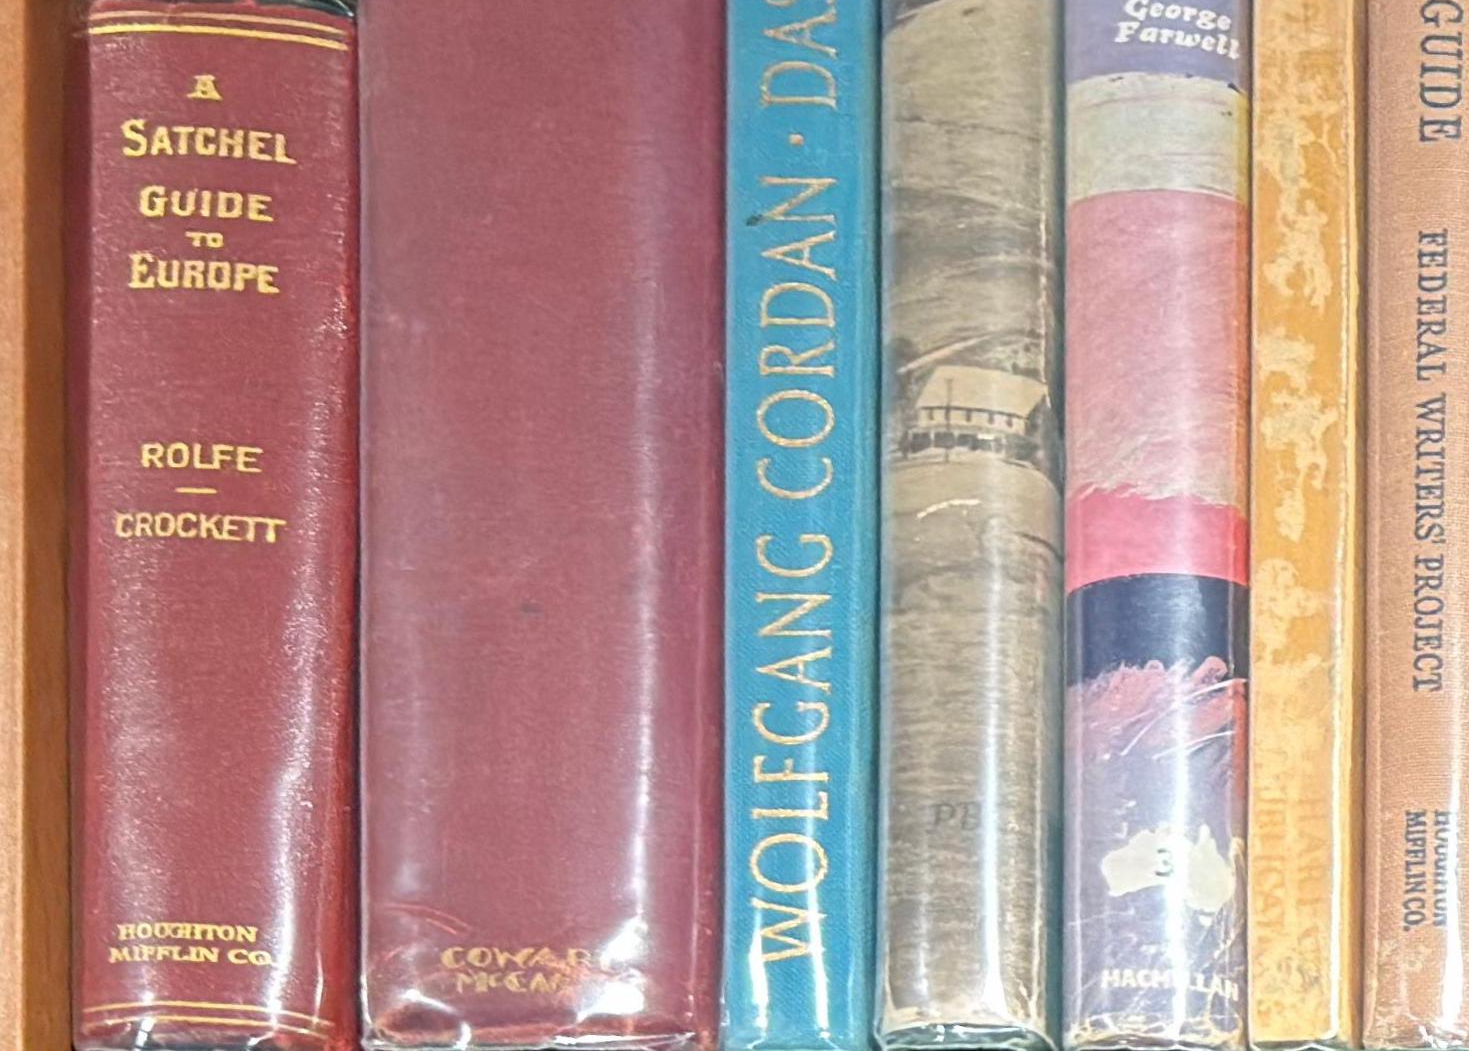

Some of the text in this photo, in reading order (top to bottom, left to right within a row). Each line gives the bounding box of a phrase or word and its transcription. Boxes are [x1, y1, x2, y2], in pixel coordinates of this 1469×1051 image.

[1113, 21, 1241, 60] Farwell
[187, 74, 223, 100] A
[120, 117, 297, 165] SATCHEL
[139, 185, 274, 222] GUIDE
[185, 231, 224, 248] TO
[128, 251, 280, 294] EUROPE
[1416, 228, 1448, 381] FEDERAL
[757, 174, 840, 501] CORDAN
[140, 441, 264, 473] ROLFE
[114, 511, 287, 544] CROCKETT
[1412, 553, 1445, 693] PROJECT
[748, 530, 835, 967] WOLFGANG
[1402, 809, 1427, 932] MIFFLIN CO.
[116, 922, 258, 942] HOUGHTON
[108, 944, 219, 964] MIFFLIN
